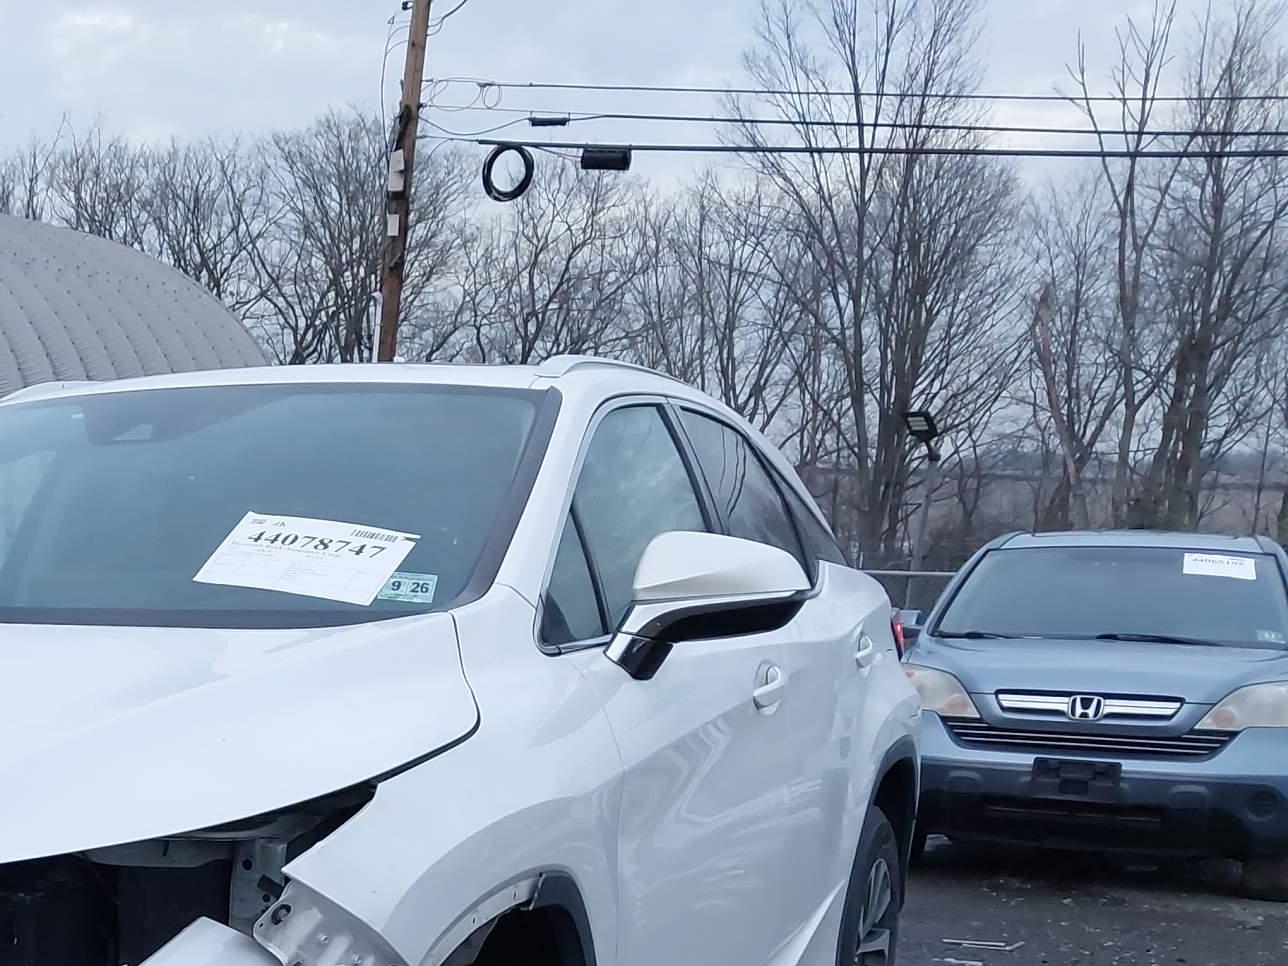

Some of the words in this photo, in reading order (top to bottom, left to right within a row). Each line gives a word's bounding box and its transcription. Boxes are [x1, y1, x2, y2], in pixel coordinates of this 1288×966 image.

[247, 530, 387, 559] 44078747
[391, 580, 402, 591] 9
[410, 582, 430, 594] 26
